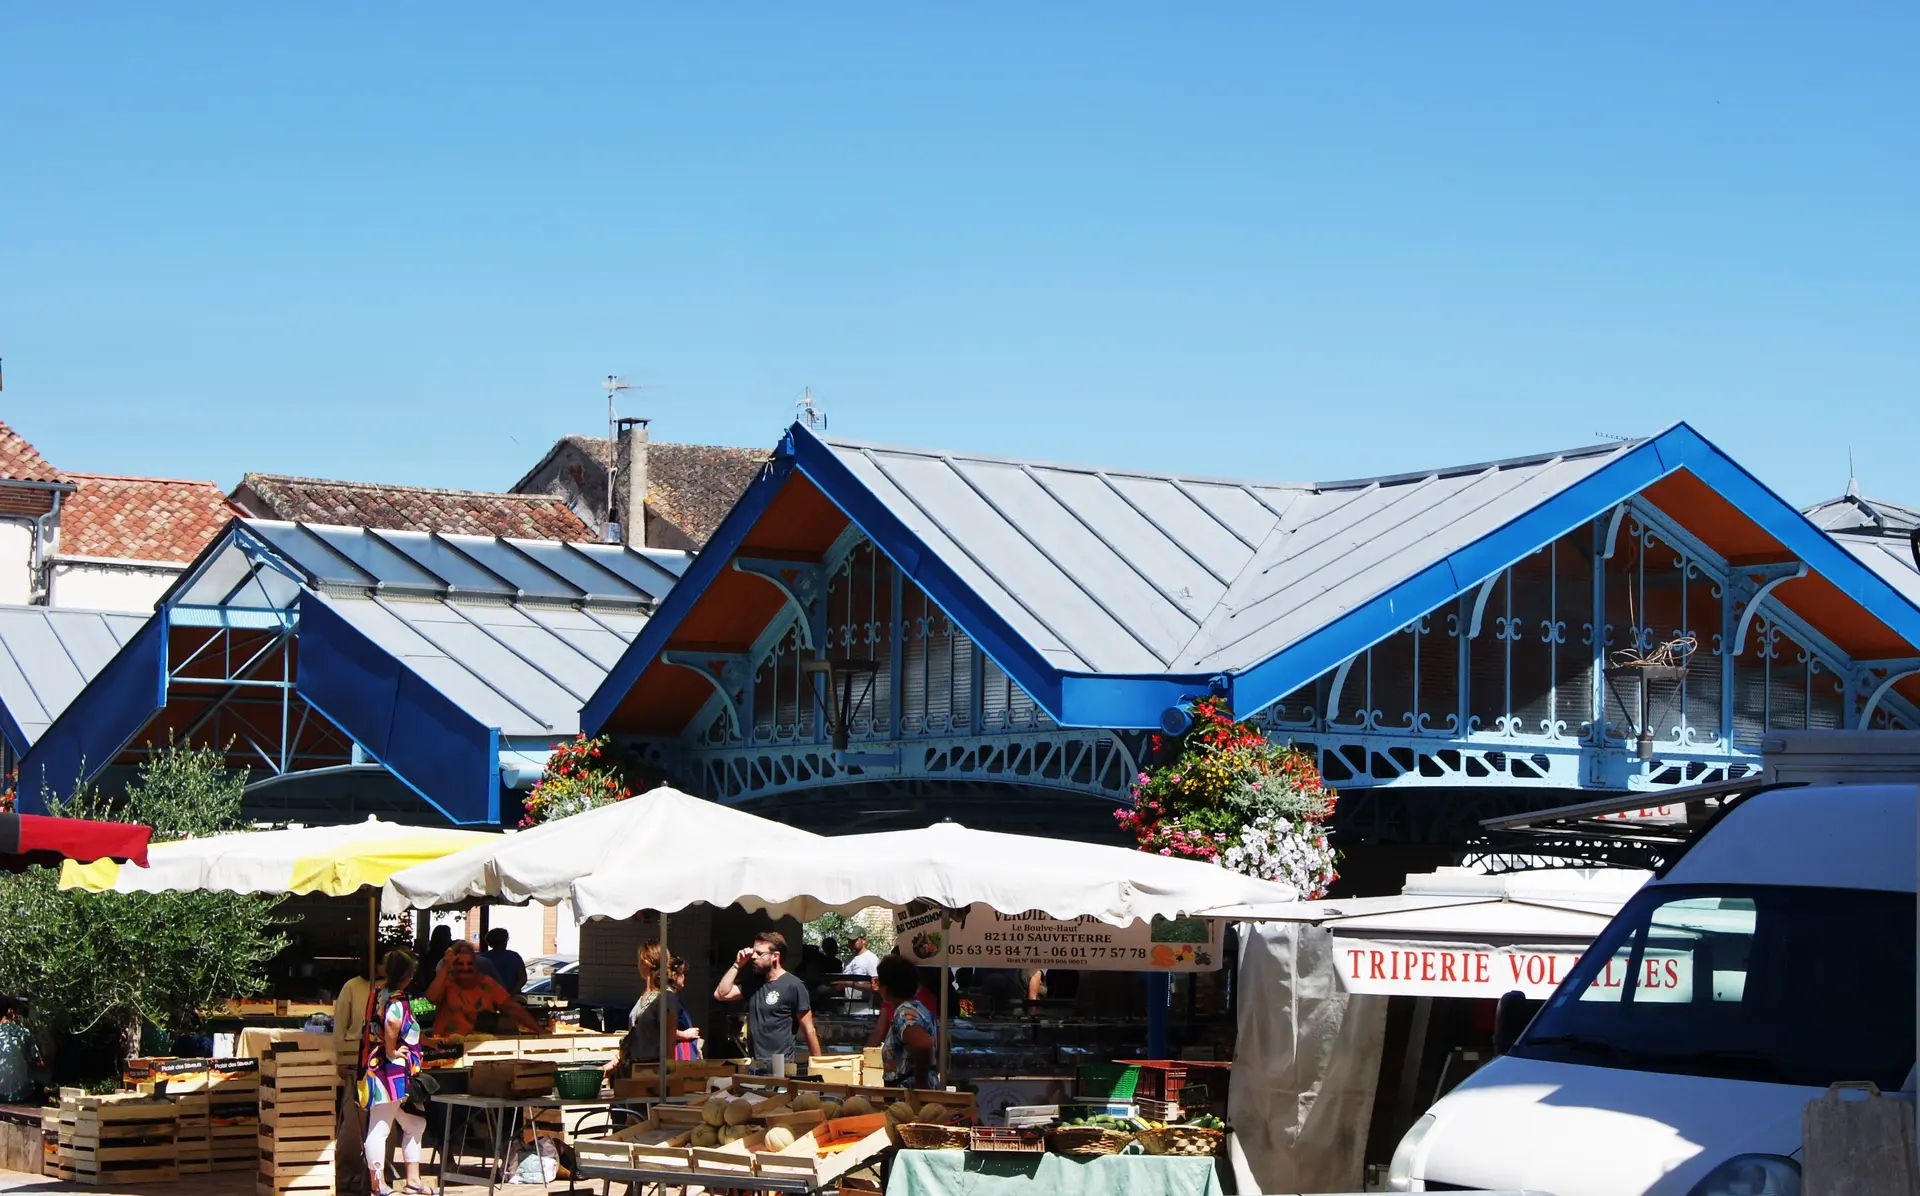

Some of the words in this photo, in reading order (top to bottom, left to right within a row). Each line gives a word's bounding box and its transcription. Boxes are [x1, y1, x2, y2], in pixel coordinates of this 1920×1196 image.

[905, 911, 942, 930] CONSOMM
[1012, 924, 1022, 932] Le
[985, 932, 1024, 942] 82110
[1027, 933, 1112, 943] SAUVETERRE
[948, 944, 963, 955] 05
[967, 945, 982, 955] 63
[986, 945, 1001, 955] 95
[1005, 945, 1020, 956] 84
[1024, 946, 1039, 956] 71
[1051, 946, 1067, 957] 06
[1070, 947, 1086, 957] 01
[1091, 947, 1107, 958] 77
[1110, 947, 1126, 958] 57
[1130, 948, 1146, 959] 78
[1347, 950, 1490, 983] TRIPERIE
[1508, 954, 1678, 989] VOLLES
